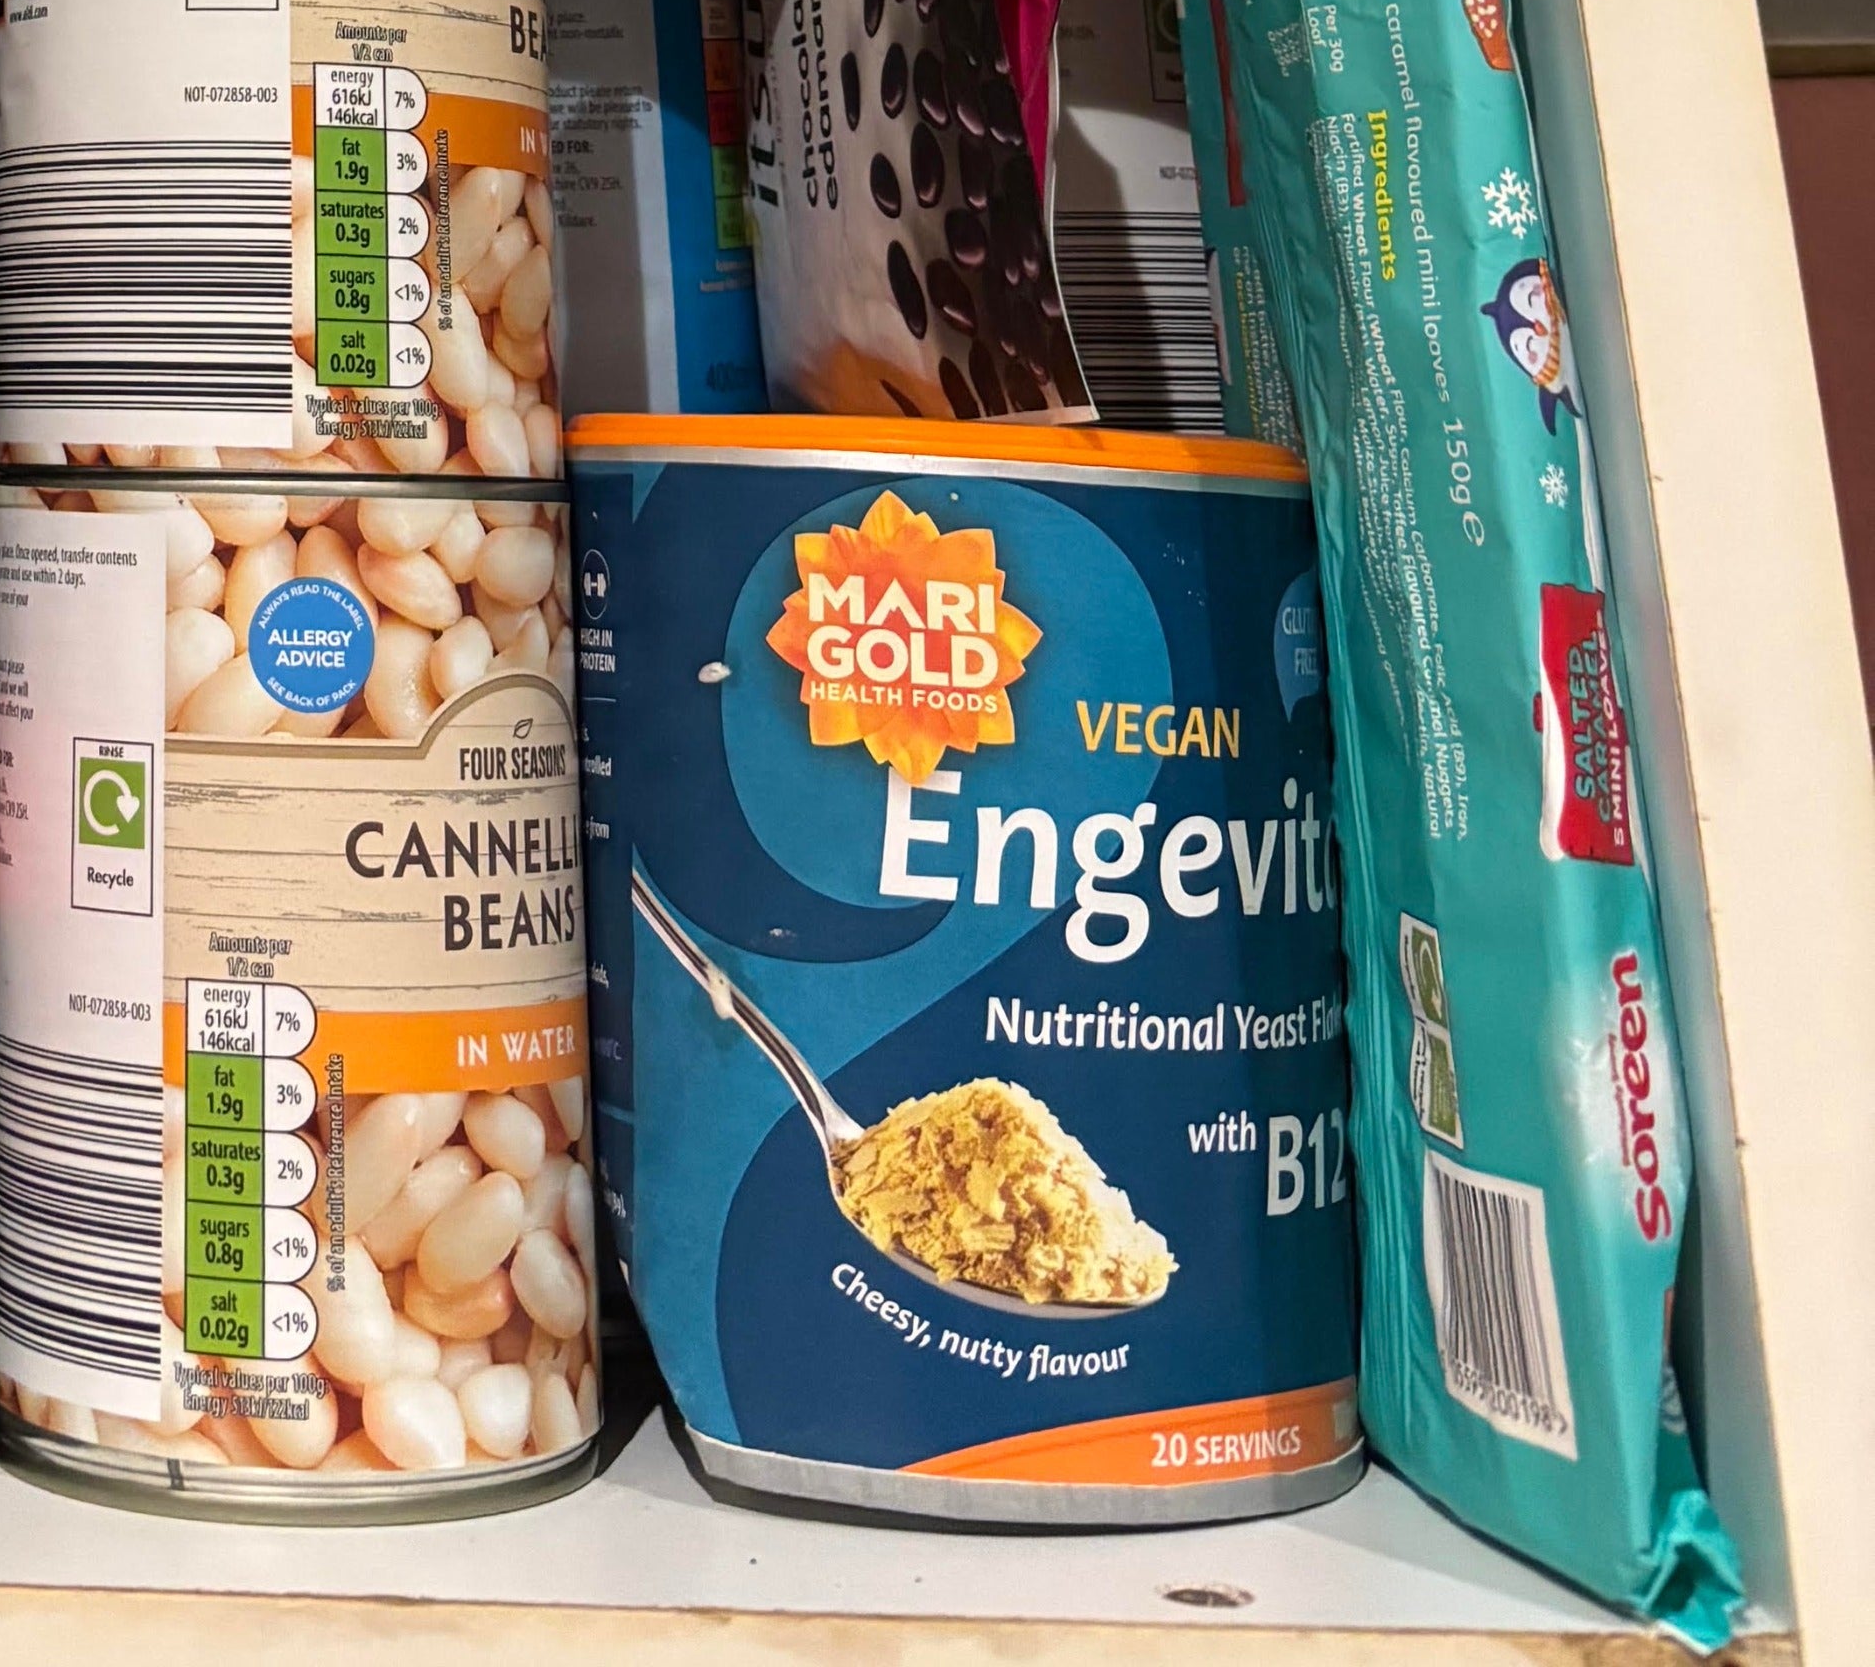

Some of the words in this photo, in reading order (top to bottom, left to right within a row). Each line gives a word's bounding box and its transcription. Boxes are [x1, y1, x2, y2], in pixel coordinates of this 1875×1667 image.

[331, 69, 373, 86] energy
[1385, 2, 1415, 108] caramel
[184, 86, 278, 104] NOT-072858-003
[326, 106, 378, 126] 146kcal
[331, 88, 371, 106] 616kJ
[395, 90, 414, 108] 7%
[335, 161, 369, 184] 1.9g
[397, 153, 417, 171] 3%
[341, 137, 360, 156] fat
[1366, 108, 1396, 280] Ingredients
[1406, 116, 1434, 242] flavoured
[321, 201, 384, 219] saturates
[335, 223, 370, 247] 0.3g
[399, 218, 418, 234] 2%
[330, 268, 375, 287] sugars
[1413, 250, 1436, 301] mini
[335, 289, 370, 313] 0.8g
[394, 284, 424, 302] <1%
[330, 354, 376, 378] 0.02g
[395, 347, 425, 365] <1%
[341, 331, 365, 350] salt
[1419, 308, 1451, 403] loaves
[1444, 418, 1471, 505] 150g
[809, 573, 996, 633] MARI
[269, 629, 353, 648] ALLERGY
[275, 649, 346, 668] ADVICE
[807, 630, 999, 688] GOLD
[810, 683, 904, 706] HEALTH
[913, 689, 997, 713] FOODS
[1077, 701, 1241, 757] VEGAN
[1569, 645, 1596, 802] SALTED
[1585, 629, 1611, 824] CARAMEL
[459, 748, 507, 781] FOUR
[511, 747, 566, 779] SEASONS
[345, 821, 579, 879] CANNELLI
[879, 769, 1339, 963] Engevit
[443, 889, 576, 951] BEANS
[457, 1035, 486, 1066] IN
[503, 1026, 576, 1058] WATER
[985, 997, 1224, 1052] Nutritional
[1235, 1006, 1307, 1048] Yeast
[1613, 950, 1673, 1242] soreen
[1188, 1113, 1257, 1152] with
[1266, 1113, 1347, 1217] B12
[831, 1263, 932, 1347] Cheesy,
[939, 1327, 1023, 1379] nutty
[1027, 1344, 1130, 1380] flavour
[1151, 1433, 1188, 1466] 20
[1194, 1426, 1301, 1466] SERVINGS
